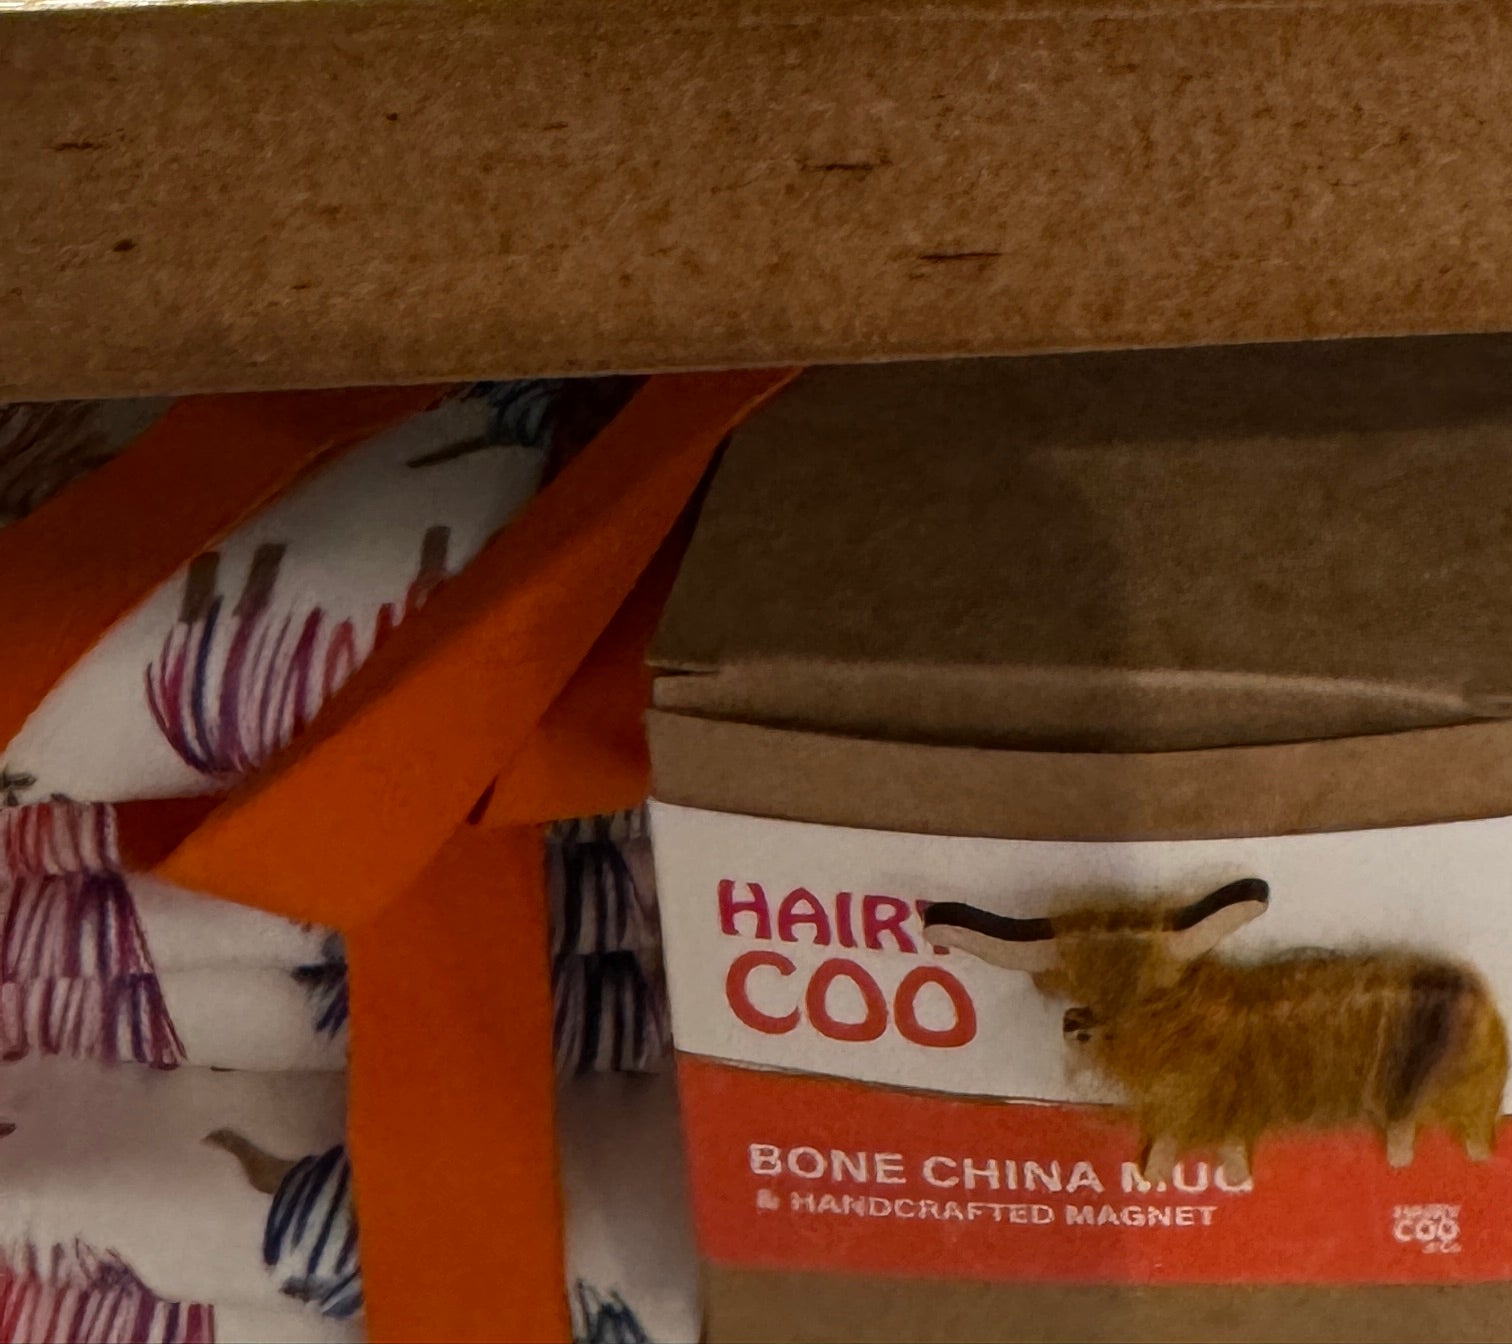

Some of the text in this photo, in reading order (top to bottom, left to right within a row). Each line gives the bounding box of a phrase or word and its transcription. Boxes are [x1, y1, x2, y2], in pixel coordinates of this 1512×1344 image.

[725, 950, 978, 1048] COO
[748, 1143, 907, 1185] BONE
[921, 1156, 1105, 1194] CHINA
[790, 1191, 1055, 1225] HANDCRAFTED
[1064, 1204, 1219, 1229] MAGNET
